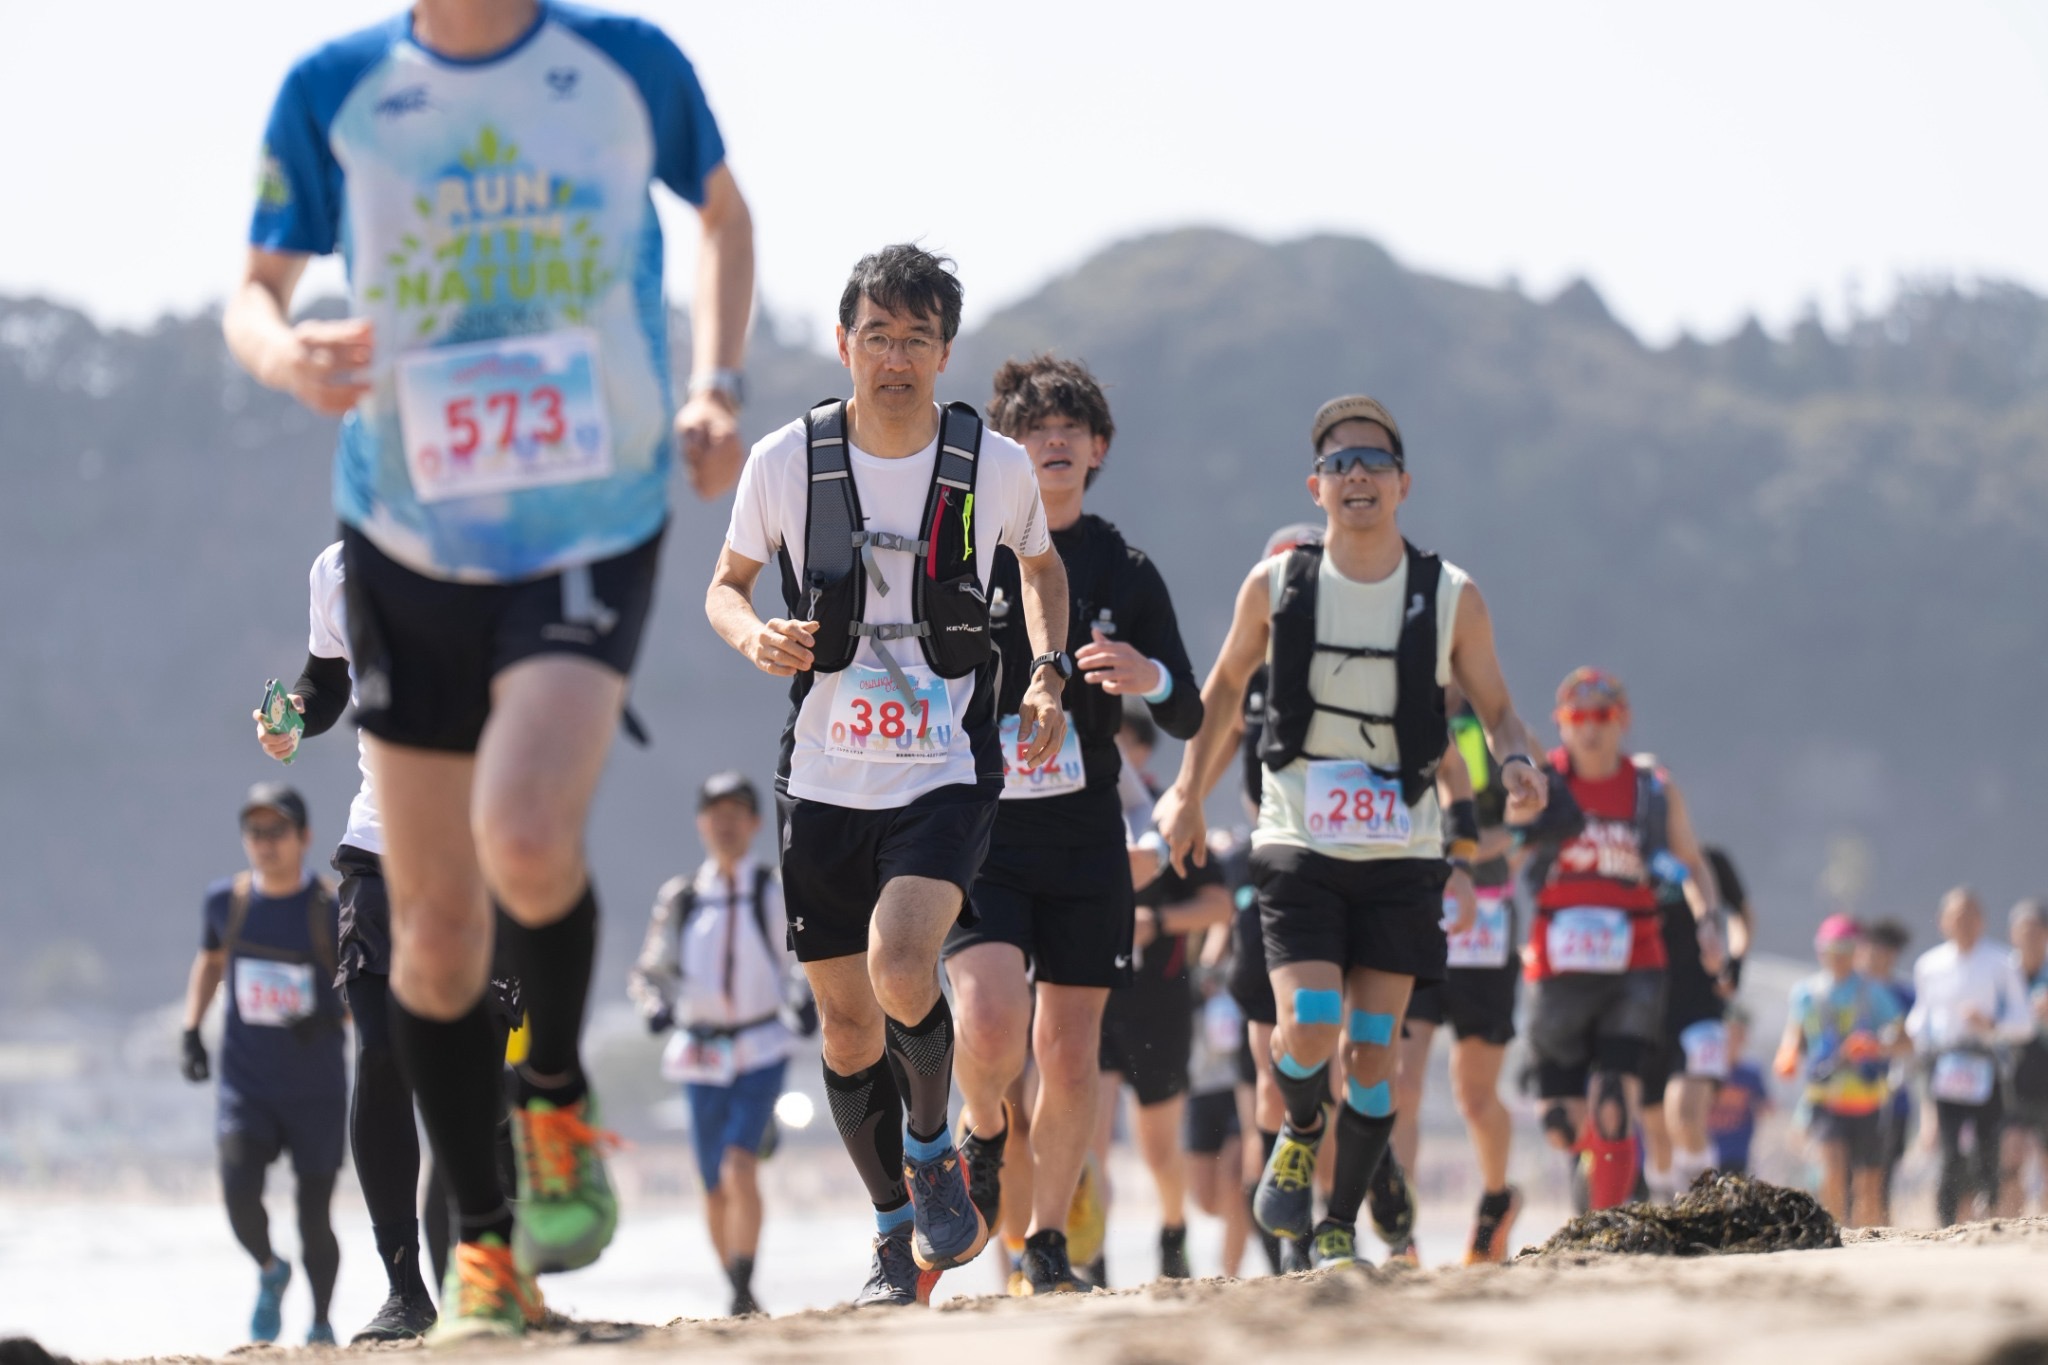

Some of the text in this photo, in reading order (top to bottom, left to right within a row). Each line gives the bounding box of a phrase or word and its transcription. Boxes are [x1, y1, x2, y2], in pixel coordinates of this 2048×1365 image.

[446, 385, 567, 456] 573
[850, 698, 929, 739] 387
[1328, 788, 1397, 822] 287
